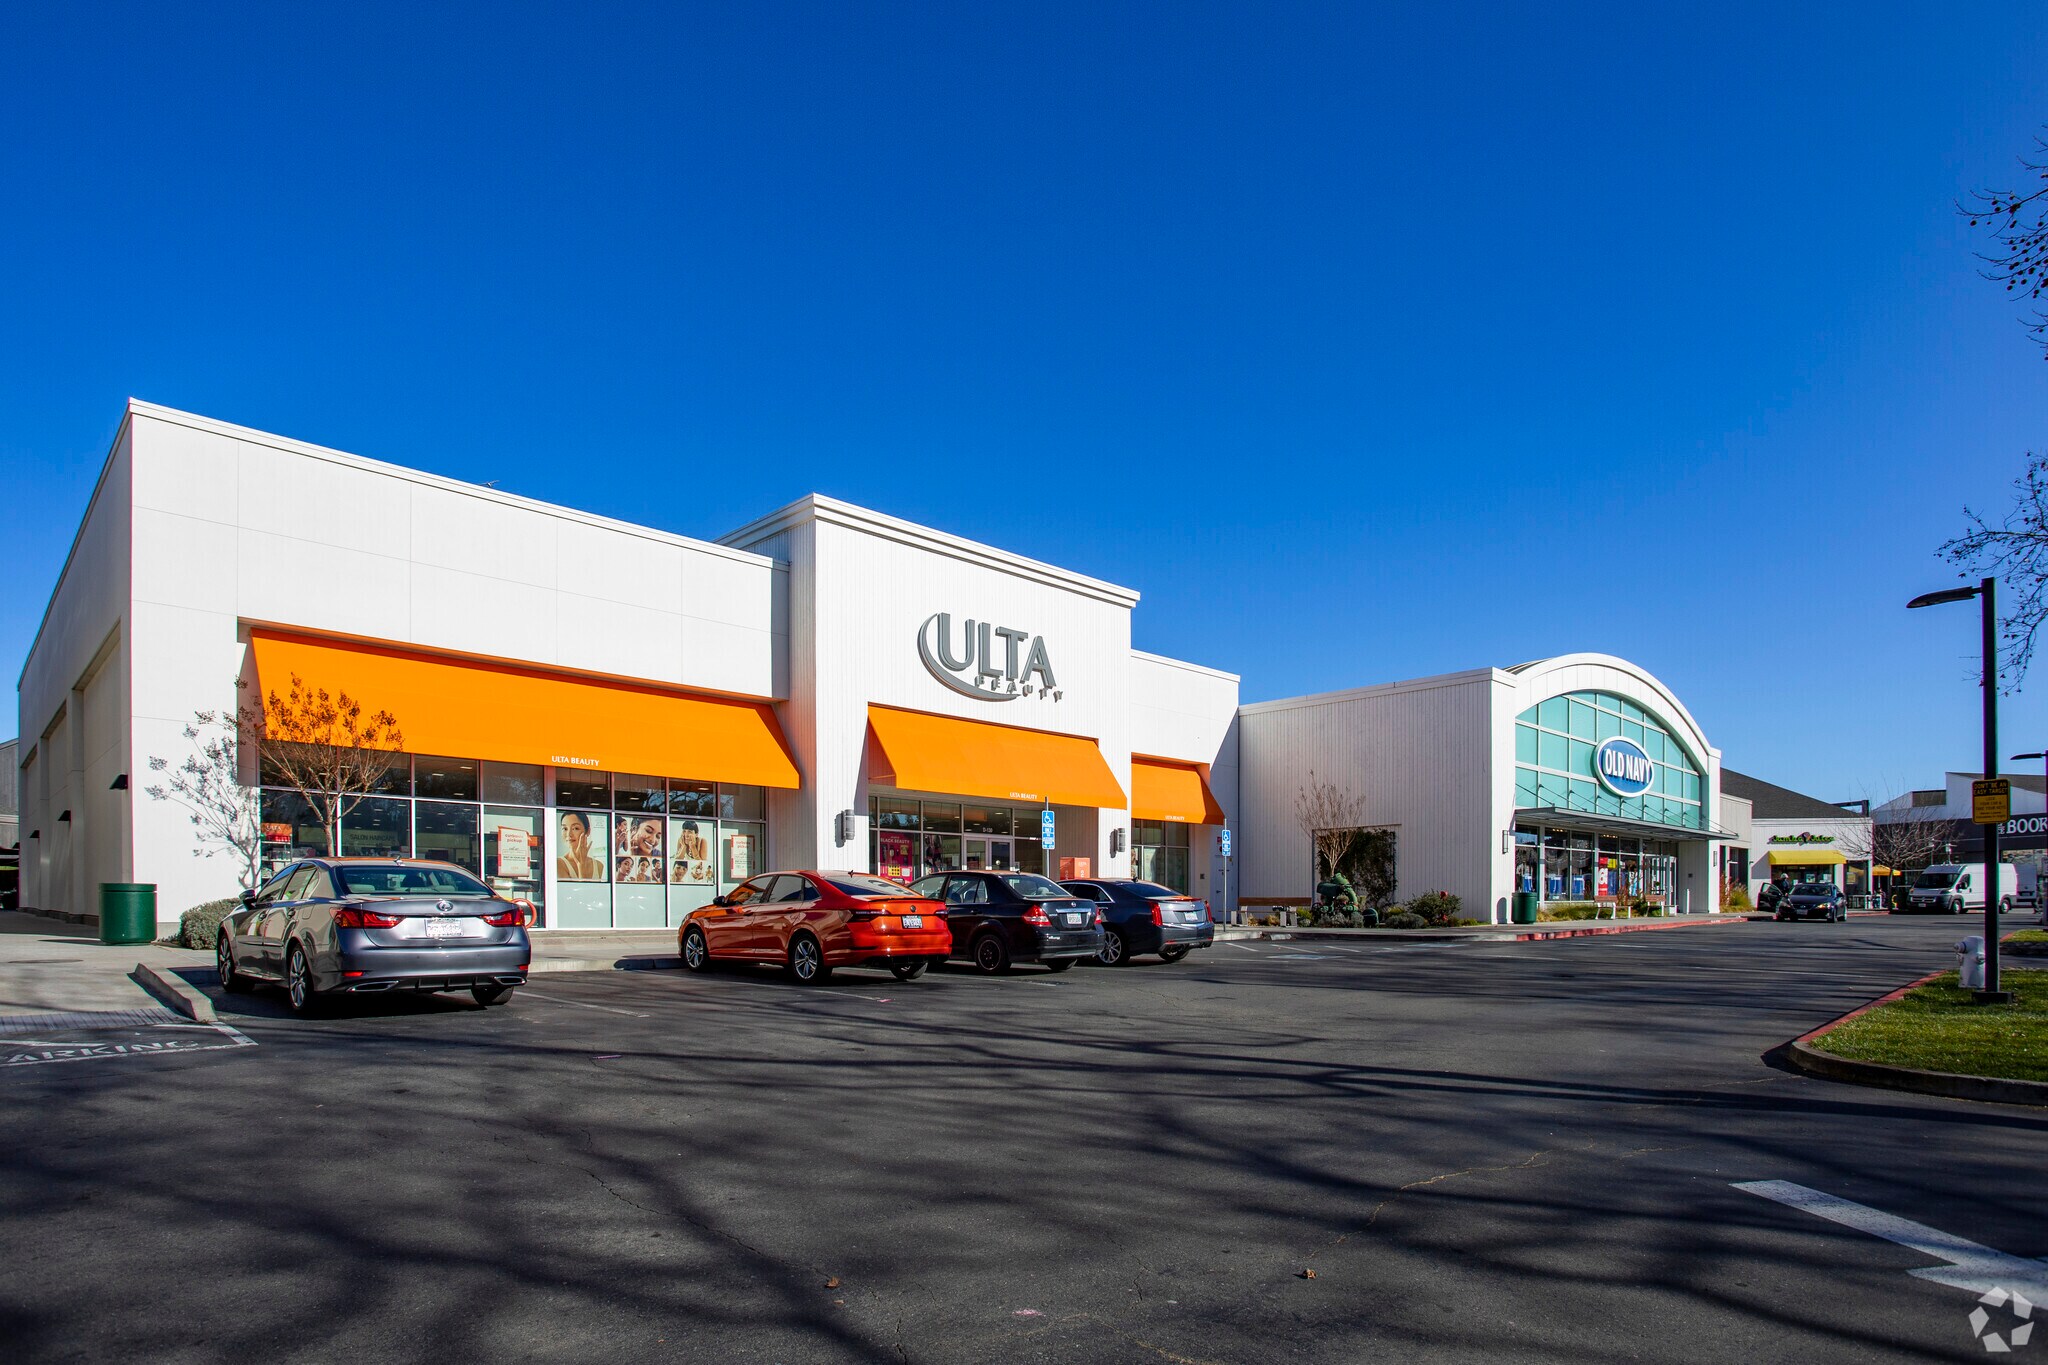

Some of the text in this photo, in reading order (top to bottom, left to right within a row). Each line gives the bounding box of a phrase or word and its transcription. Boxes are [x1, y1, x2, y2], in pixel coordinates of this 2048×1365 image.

[937, 612, 1057, 689] ULTA
[974, 675, 1064, 702] BEAUTY
[551, 755, 599, 766] ULTA BEAUTY
[1604, 748, 1651, 783] OLD NAVY
[1021, 792, 1037, 800] BEAUTY
[0, 1041, 198, 1062] ARKING
